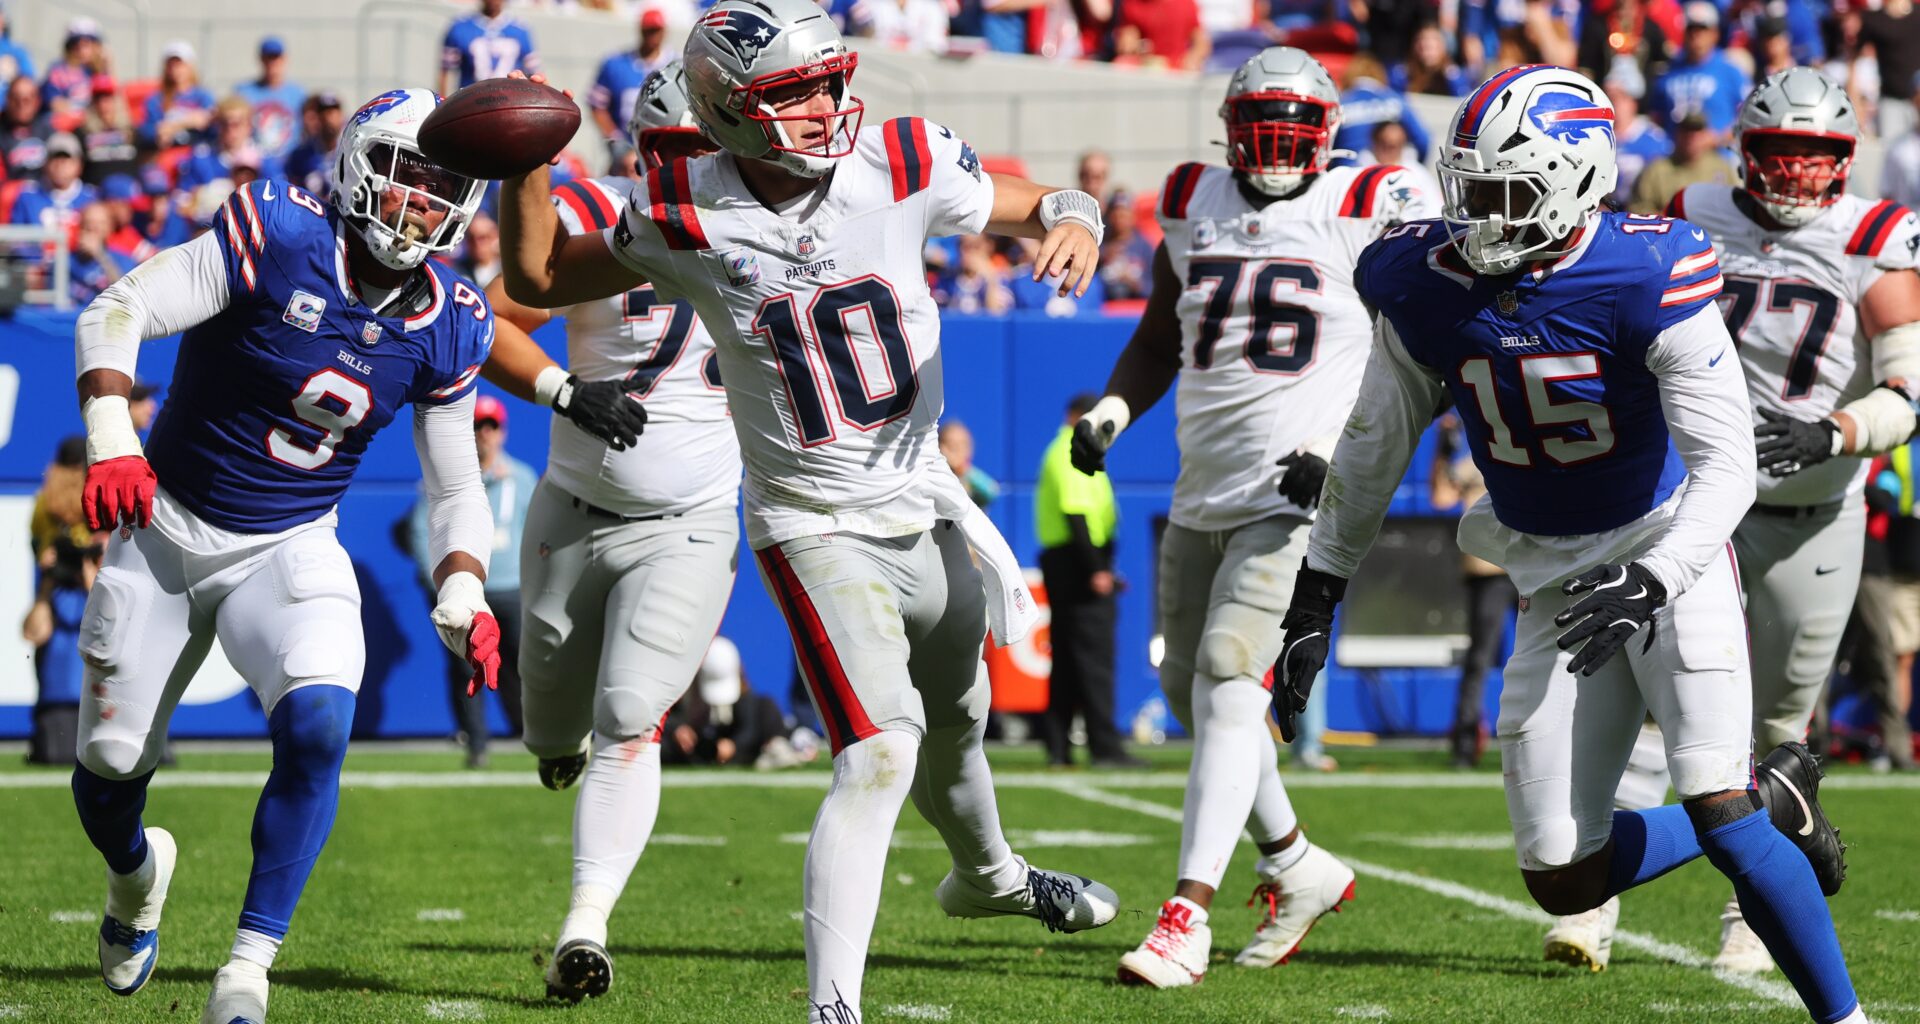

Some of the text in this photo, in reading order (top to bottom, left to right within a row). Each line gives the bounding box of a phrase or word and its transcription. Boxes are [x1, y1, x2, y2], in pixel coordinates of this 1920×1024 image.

[1381, 217, 1433, 242] 5
[453, 281, 488, 321] 9
[785, 259, 836, 281] PATRIOTS
[1184, 256, 1325, 377] 76
[1500, 335, 1541, 348] BILLS
[1717, 273, 1844, 401] 77
[336, 349, 373, 375] BILLS
[751, 273, 920, 449] 10
[264, 365, 375, 471] 9
[1458, 351, 1616, 469] 15
